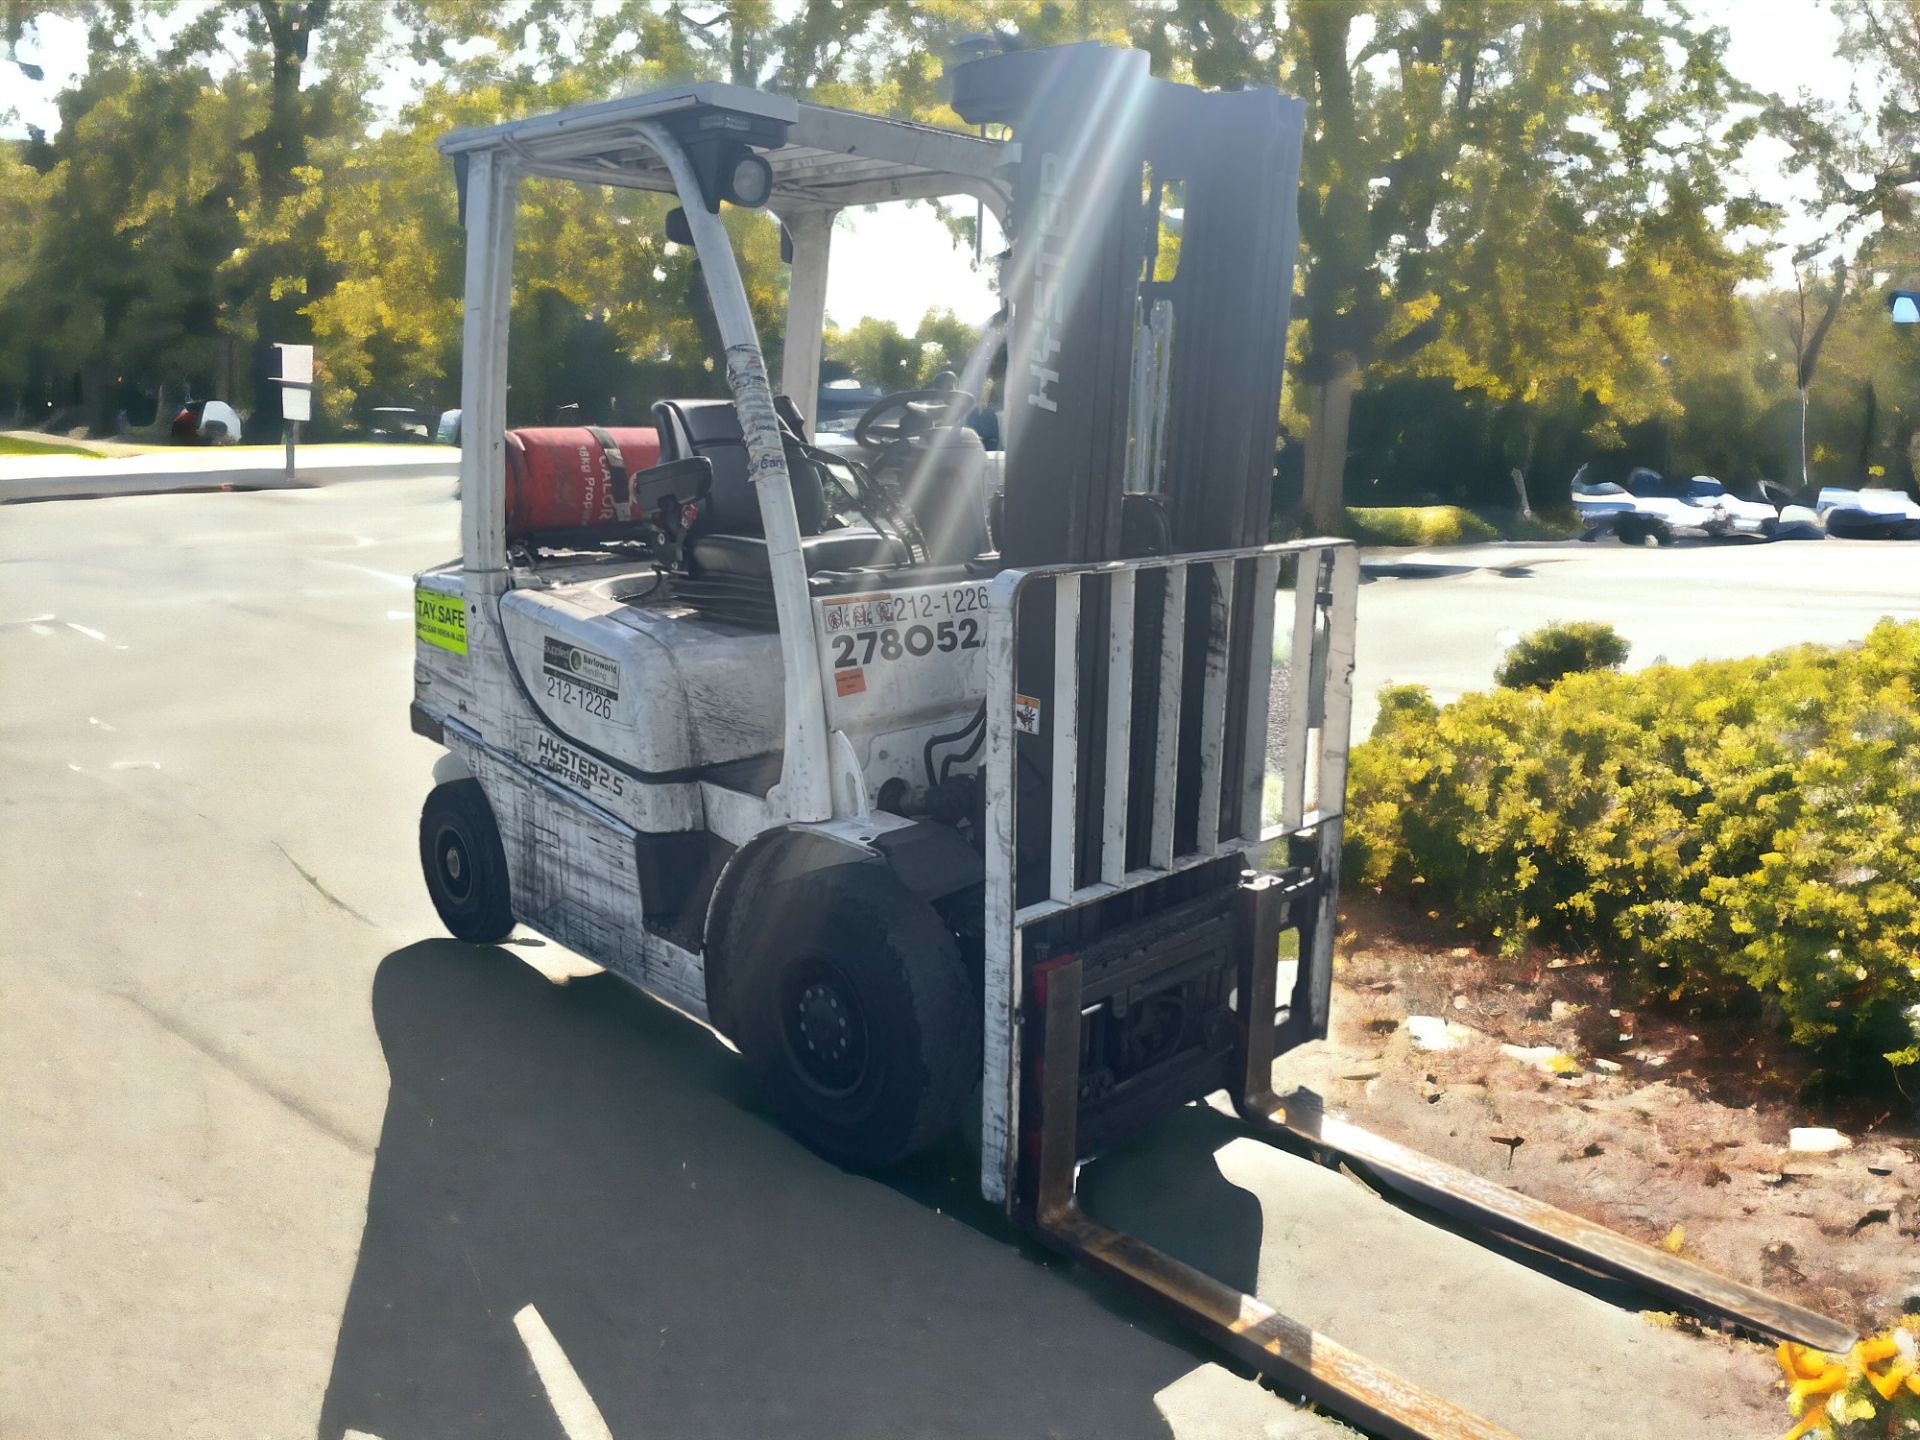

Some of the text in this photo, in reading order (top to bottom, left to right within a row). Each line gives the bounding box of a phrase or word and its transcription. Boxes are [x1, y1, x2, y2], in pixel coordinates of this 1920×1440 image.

[1027, 152, 1068, 413] HYSTER
[438, 605, 465, 629] SAFE
[894, 586, 988, 622] 212-1226
[831, 618, 987, 669] 278052
[547, 676, 612, 720] 212-1226
[538, 733, 598, 784] HYSTER
